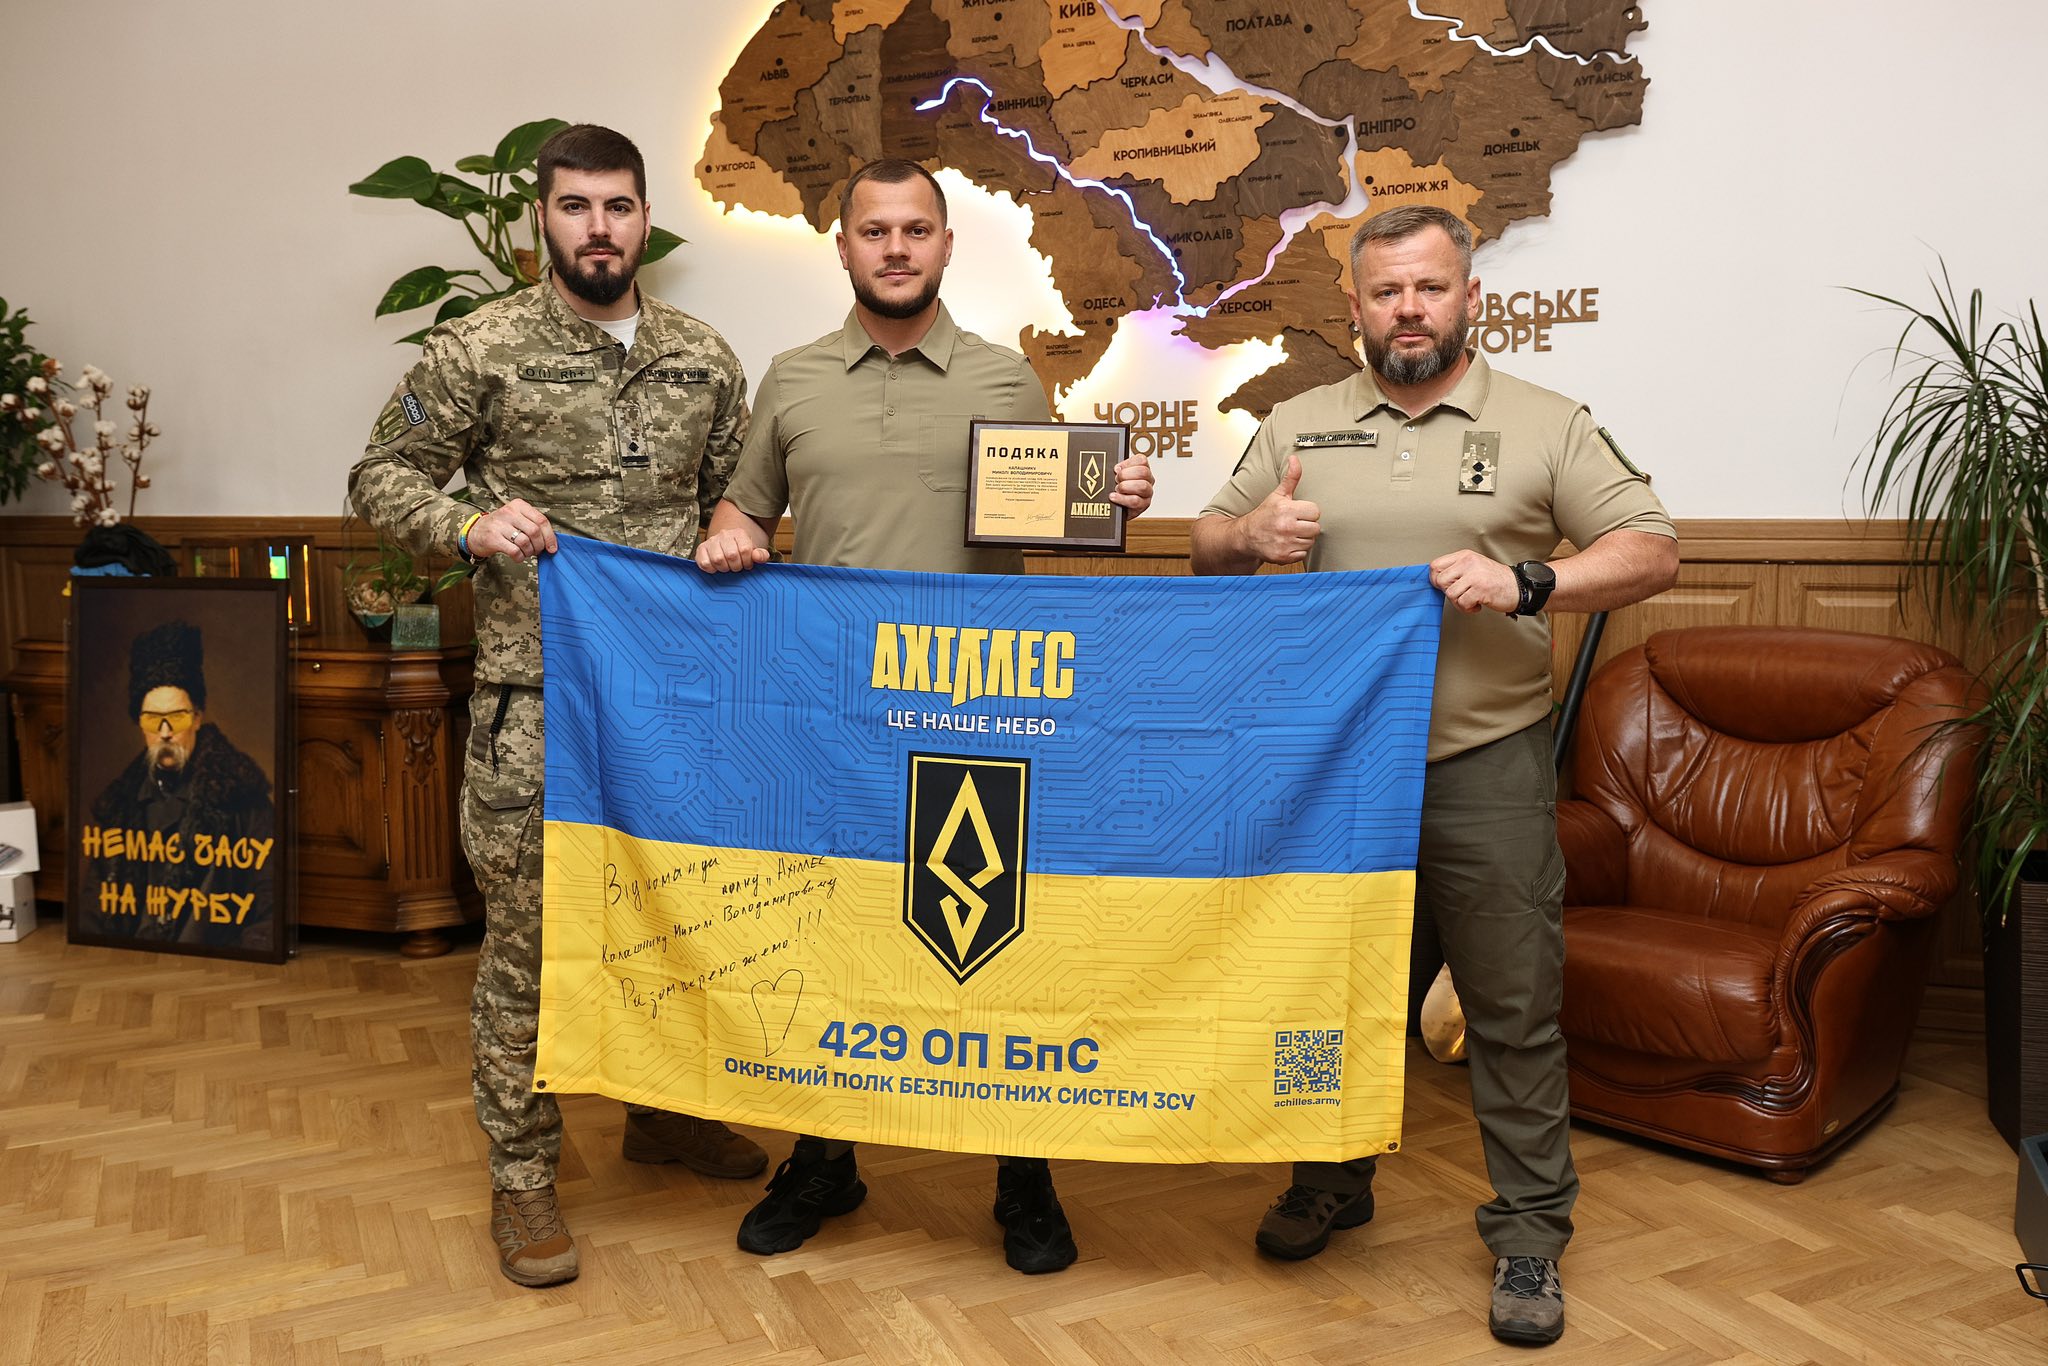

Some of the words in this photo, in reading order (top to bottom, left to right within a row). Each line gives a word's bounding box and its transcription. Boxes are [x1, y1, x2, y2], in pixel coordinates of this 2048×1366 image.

[1059, 0, 1096, 19] КИЇВ
[1226, 14, 1293, 32] ПОЛТАВА
[759, 68, 790, 82] ЛЬВІВ
[1121, 73, 1174, 89] ЧЕРКАСИ
[1573, 71, 1634, 87] ЛУГАНСЬК
[828, 94, 871, 106] ТЕРНОПІЛЬ
[997, 95, 1047, 112] ВІННИЦЯ
[1357, 117, 1416, 137] ДНІПРО
[1113, 138, 1216, 161] КРОПИВНИЦЬКИЙ
[1483, 140, 1541, 157] ДОНЕЦЬК
[715, 161, 756, 172] УЖГОРОД
[1371, 180, 1449, 197] ЗАПОРІЖЖЯ
[1166, 226, 1233, 244] МИКОЛАЇВ
[1083, 297, 1126, 311] ОДЕСА
[1219, 300, 1272, 314] ХЕРСОН
[1475, 288, 1599, 321] ВСЬКЕ
[560, 369, 586, 380] Rh+
[1094, 400, 1198, 429] ЧОРНЕ
[1131, 429, 1193, 458] ОРЕ
[1327, 433, 1346, 442] СИЛИ
[987, 446, 1059, 460] ПОДЯКА
[1070, 502, 1111, 516] АХІЛЛЕС
[870, 622, 1076, 708] АХІЛЛЕС
[886, 709, 917, 731] ЦЕ
[922, 711, 990, 734] НАШЕ
[996, 715, 1056, 736] НЕБО
[82, 825, 186, 864] НЕМАЄ
[193, 833, 274, 870] ЧАСУ
[98, 881, 137, 916] НА
[145, 884, 255, 925] ЖУРБУ
[817, 1020, 908, 1062] 429
[921, 1028, 990, 1069] ОП
[1003, 1036, 1100, 1075] БпС
[723, 1056, 828, 1087] ОКРЕМИЙ
[833, 1073, 893, 1094] ПОЛК
[899, 1077, 1051, 1104] БЕЗПІЛОТНИХ
[1057, 1086, 1149, 1110] СИСТЕМ
[1152, 1091, 1197, 1112] ЗСУ
[1273, 1097, 1341, 1108] achilles.army
